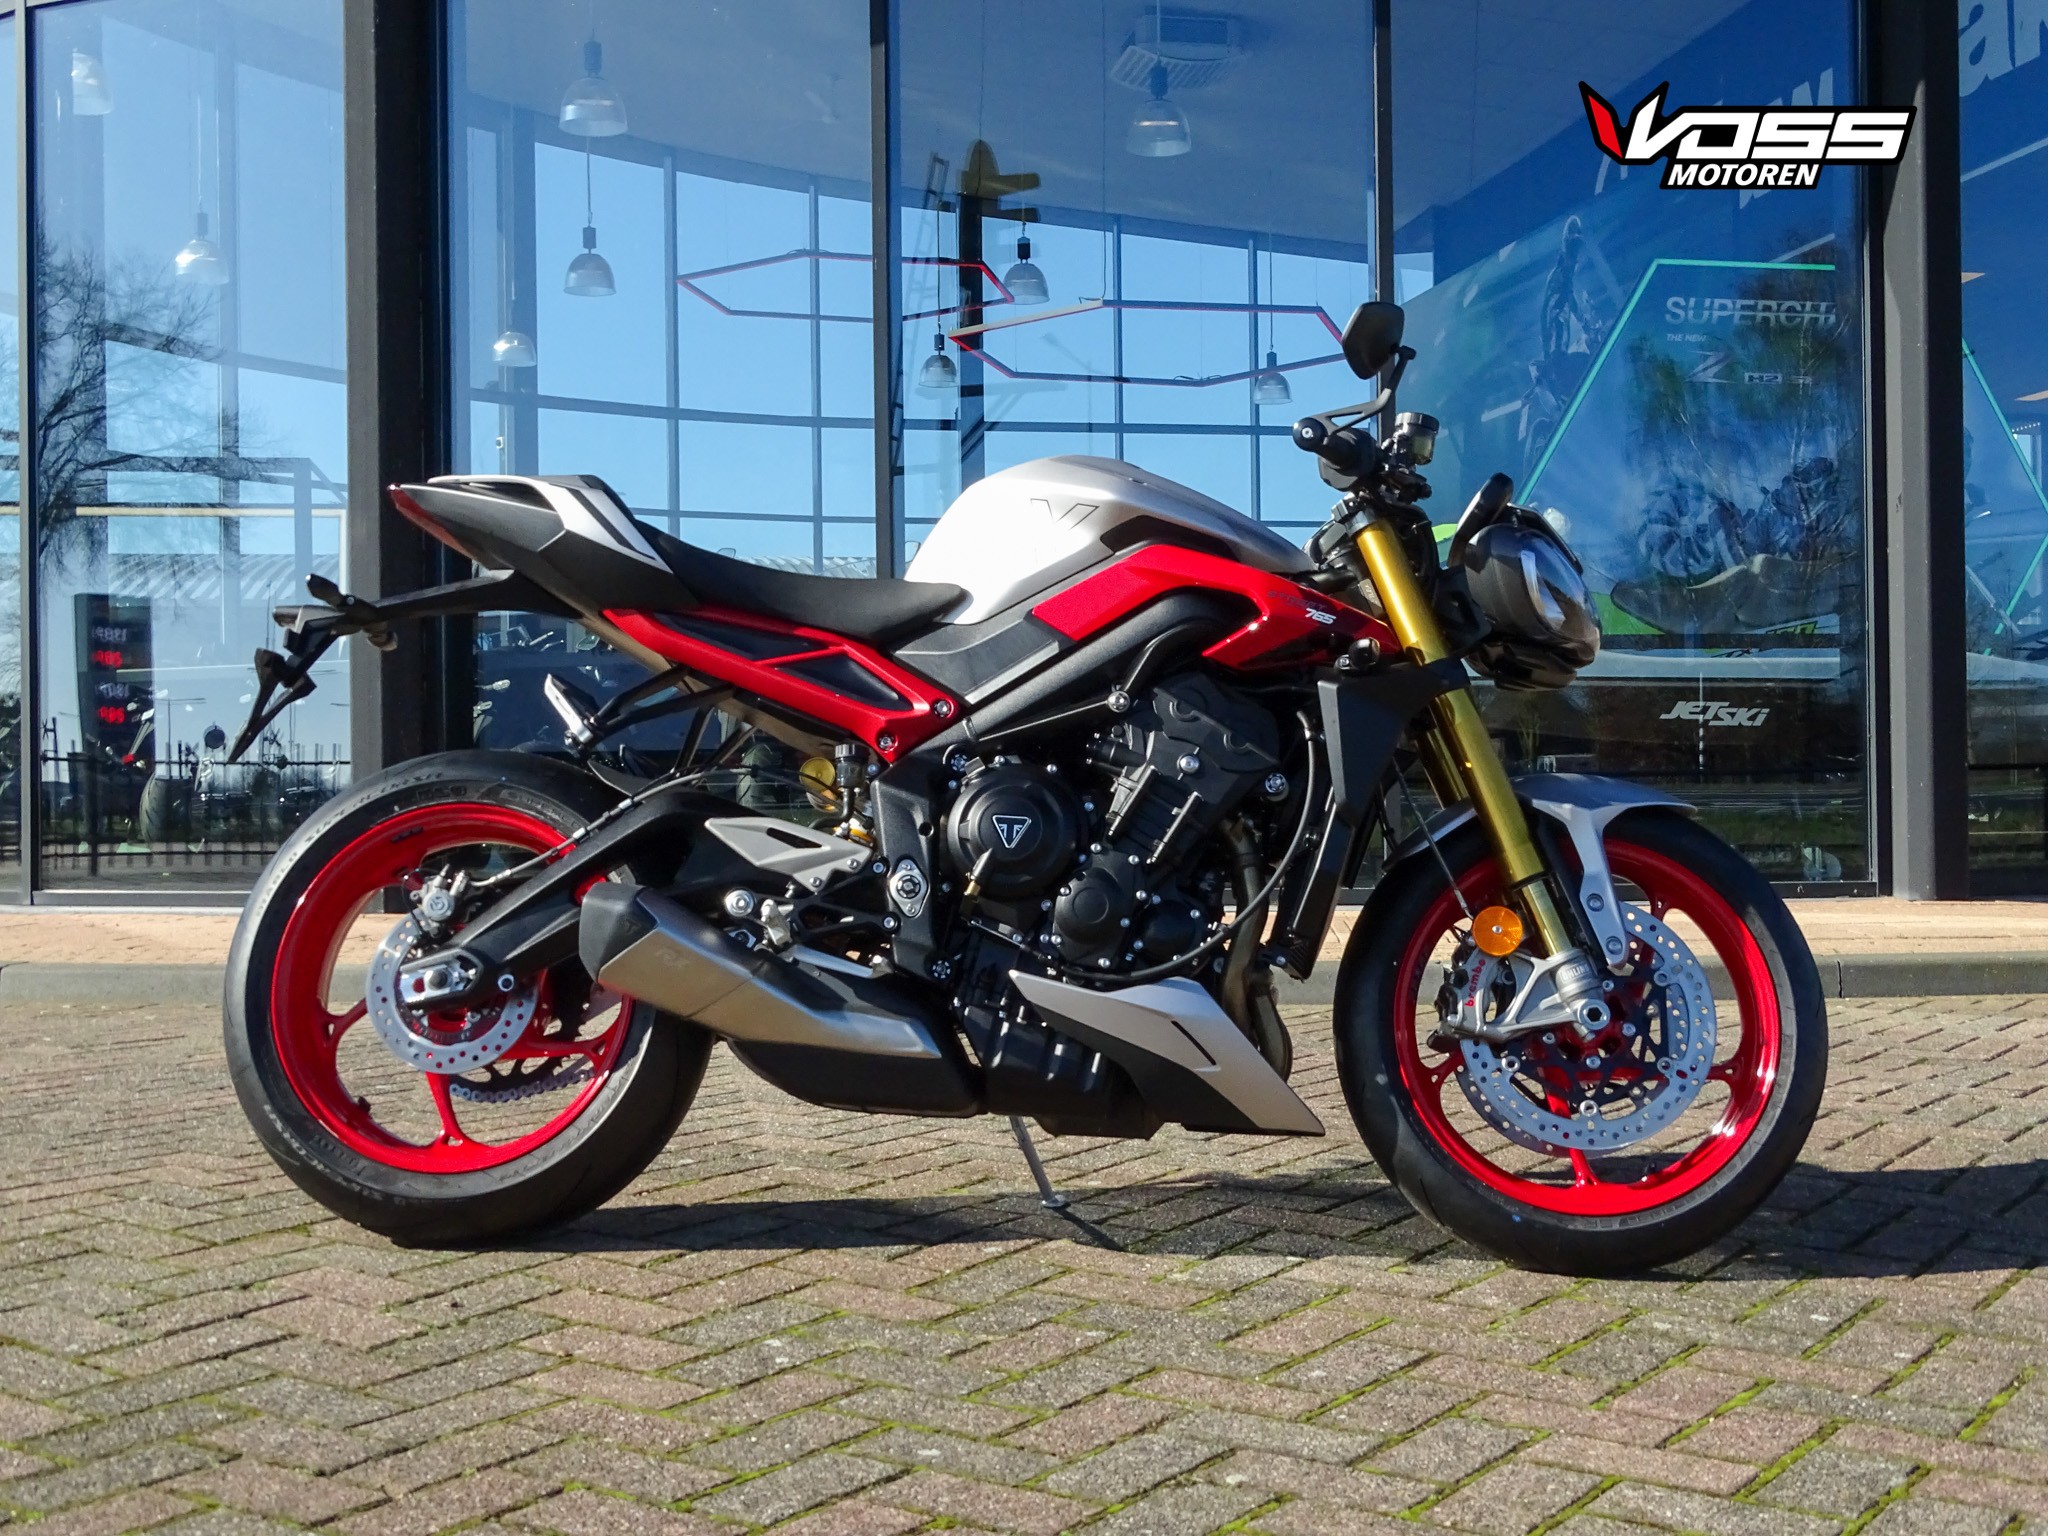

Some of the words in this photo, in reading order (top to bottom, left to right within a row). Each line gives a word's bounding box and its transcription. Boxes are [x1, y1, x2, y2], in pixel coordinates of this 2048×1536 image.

[1664, 296, 1837, 327] SUPERCH
[1666, 333, 1683, 342] THE
[1304, 607, 1336, 625] 765
[1464, 958, 1486, 1007] brembo
